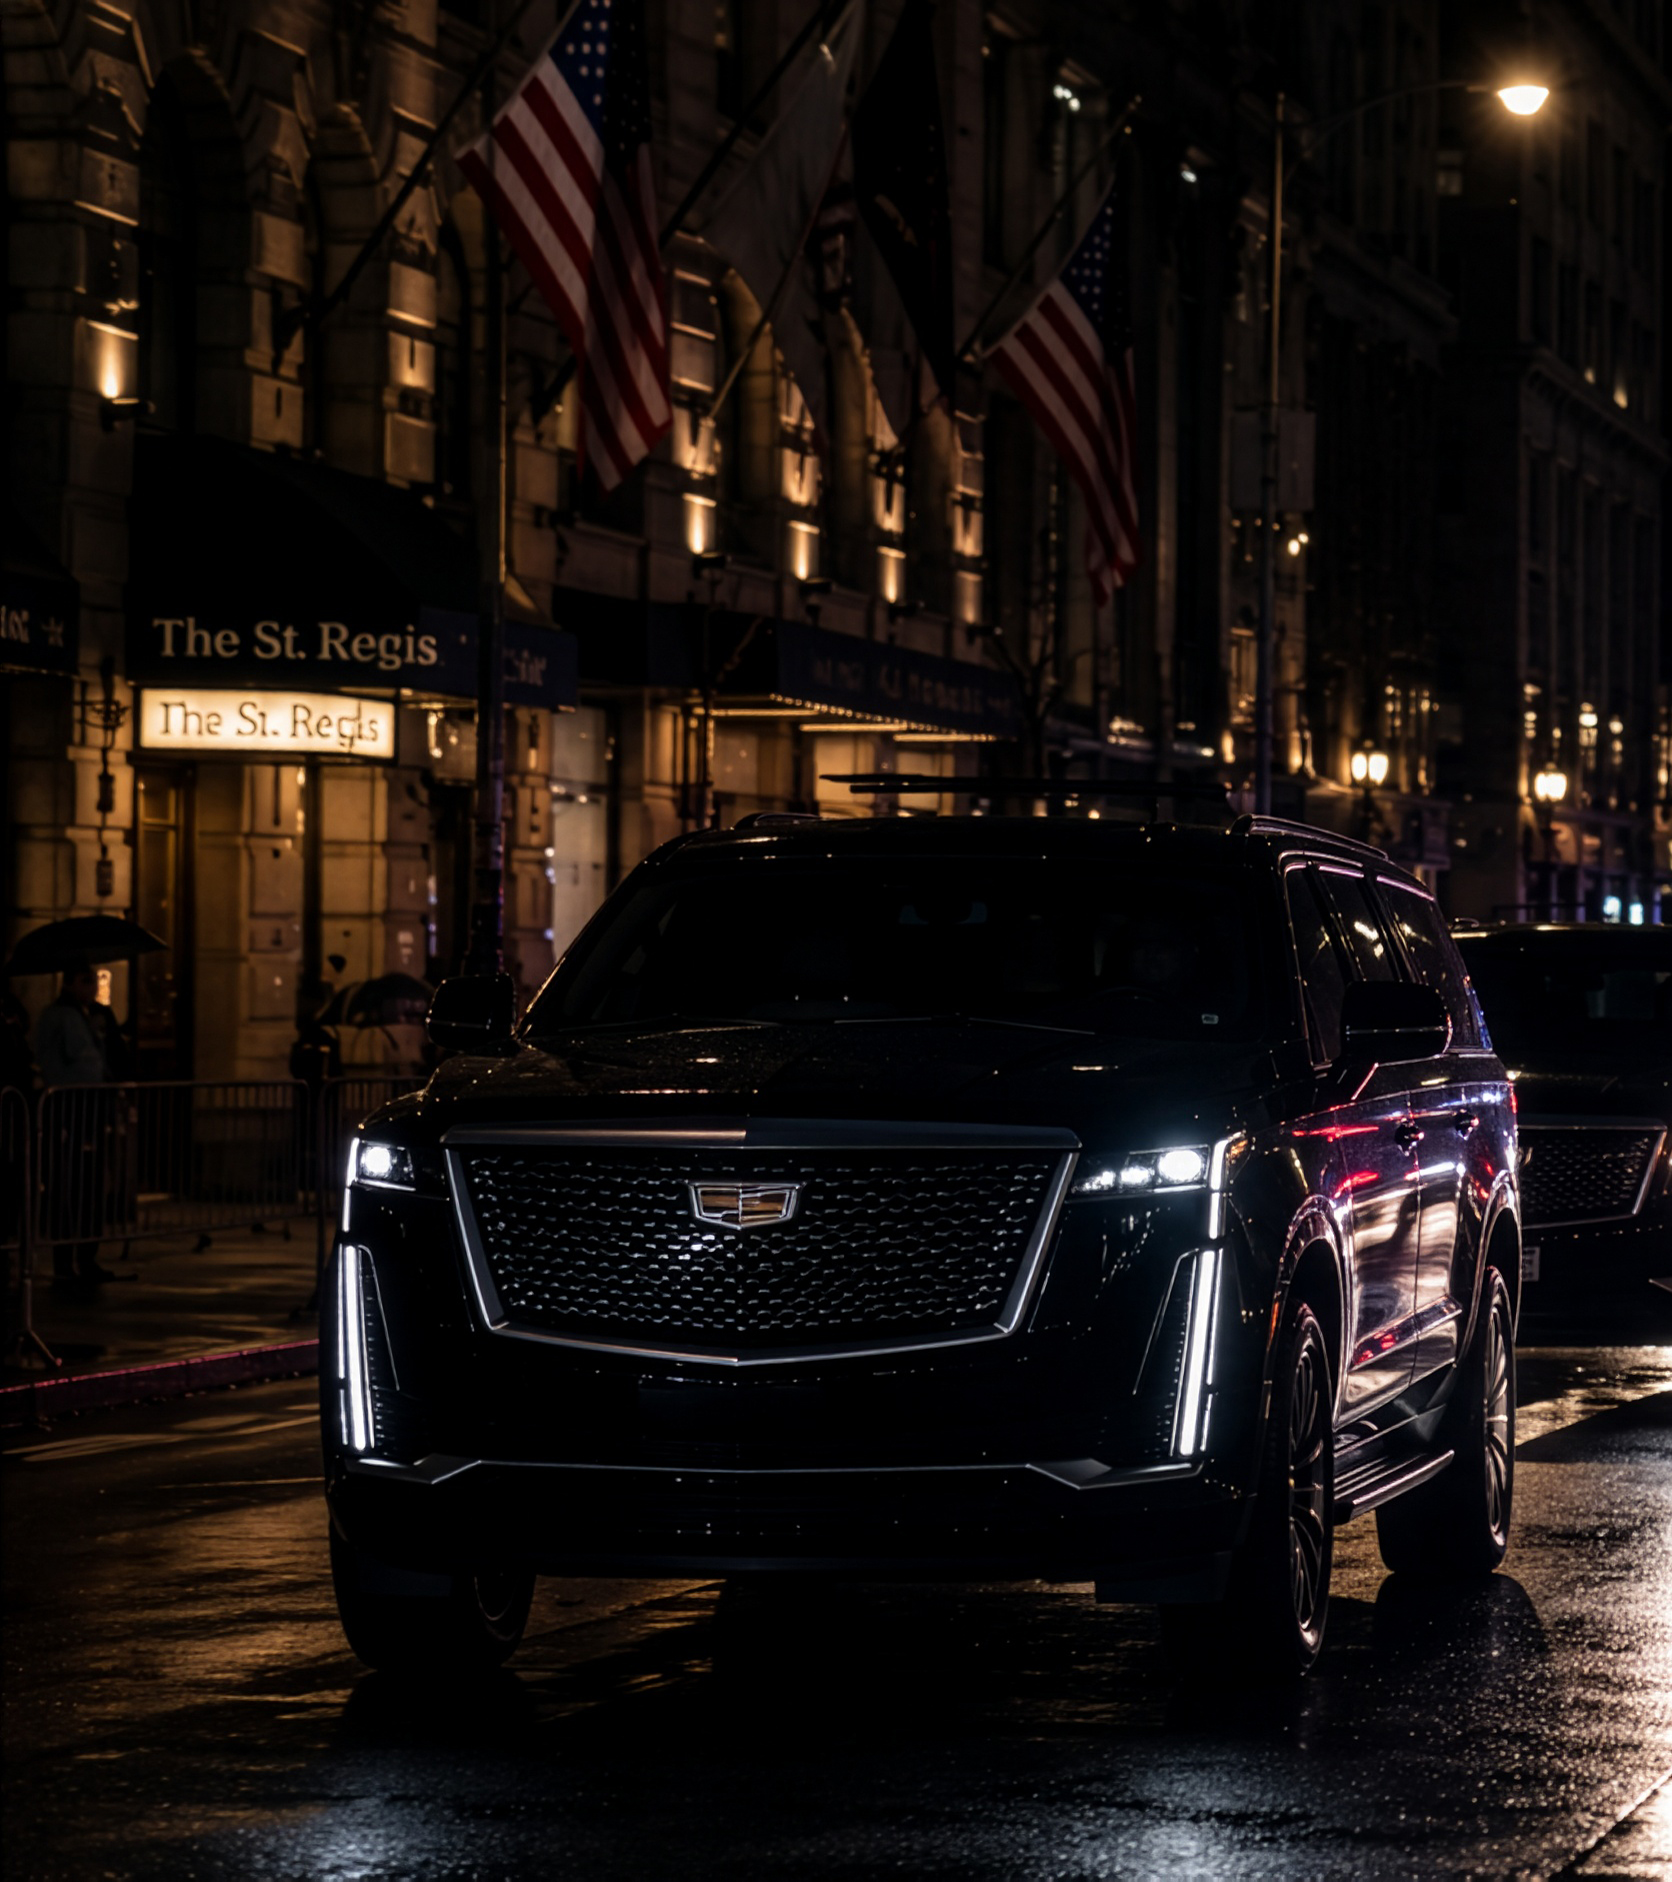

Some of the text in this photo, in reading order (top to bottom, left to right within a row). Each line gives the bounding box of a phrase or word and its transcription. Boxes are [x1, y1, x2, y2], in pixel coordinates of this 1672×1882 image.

[152, 616, 438, 671] The St. Regis
